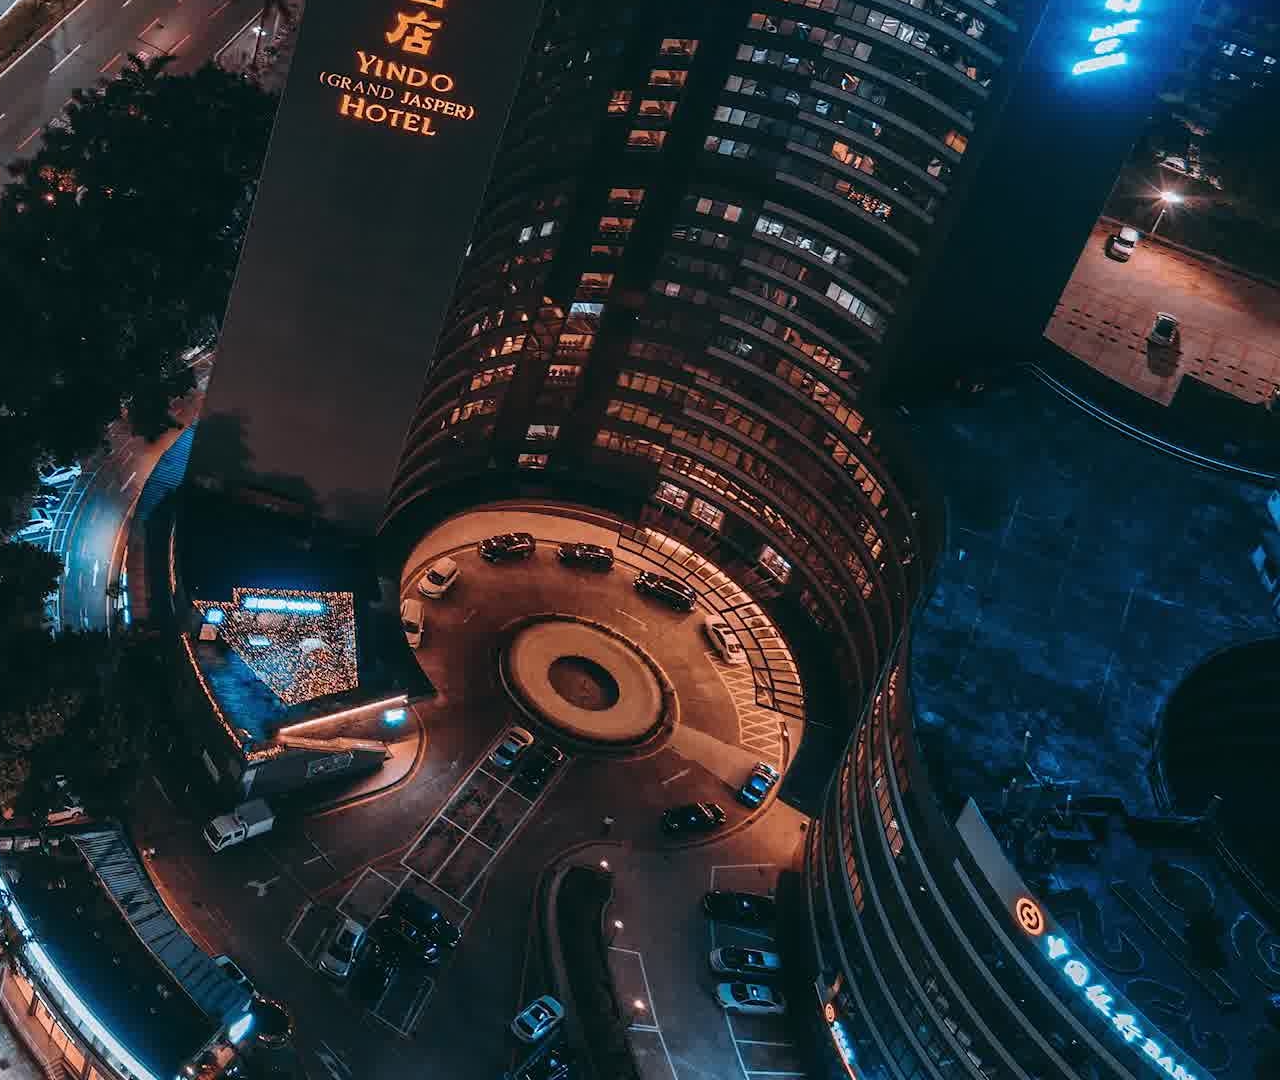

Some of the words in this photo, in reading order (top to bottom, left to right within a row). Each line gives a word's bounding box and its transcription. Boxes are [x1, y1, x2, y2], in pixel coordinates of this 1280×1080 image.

[356, 50, 454, 92] YINDO
[319, 71, 394, 100] (GRAND
[400, 91, 475, 121] JASPER)
[338, 94, 436, 136] HOTEL
